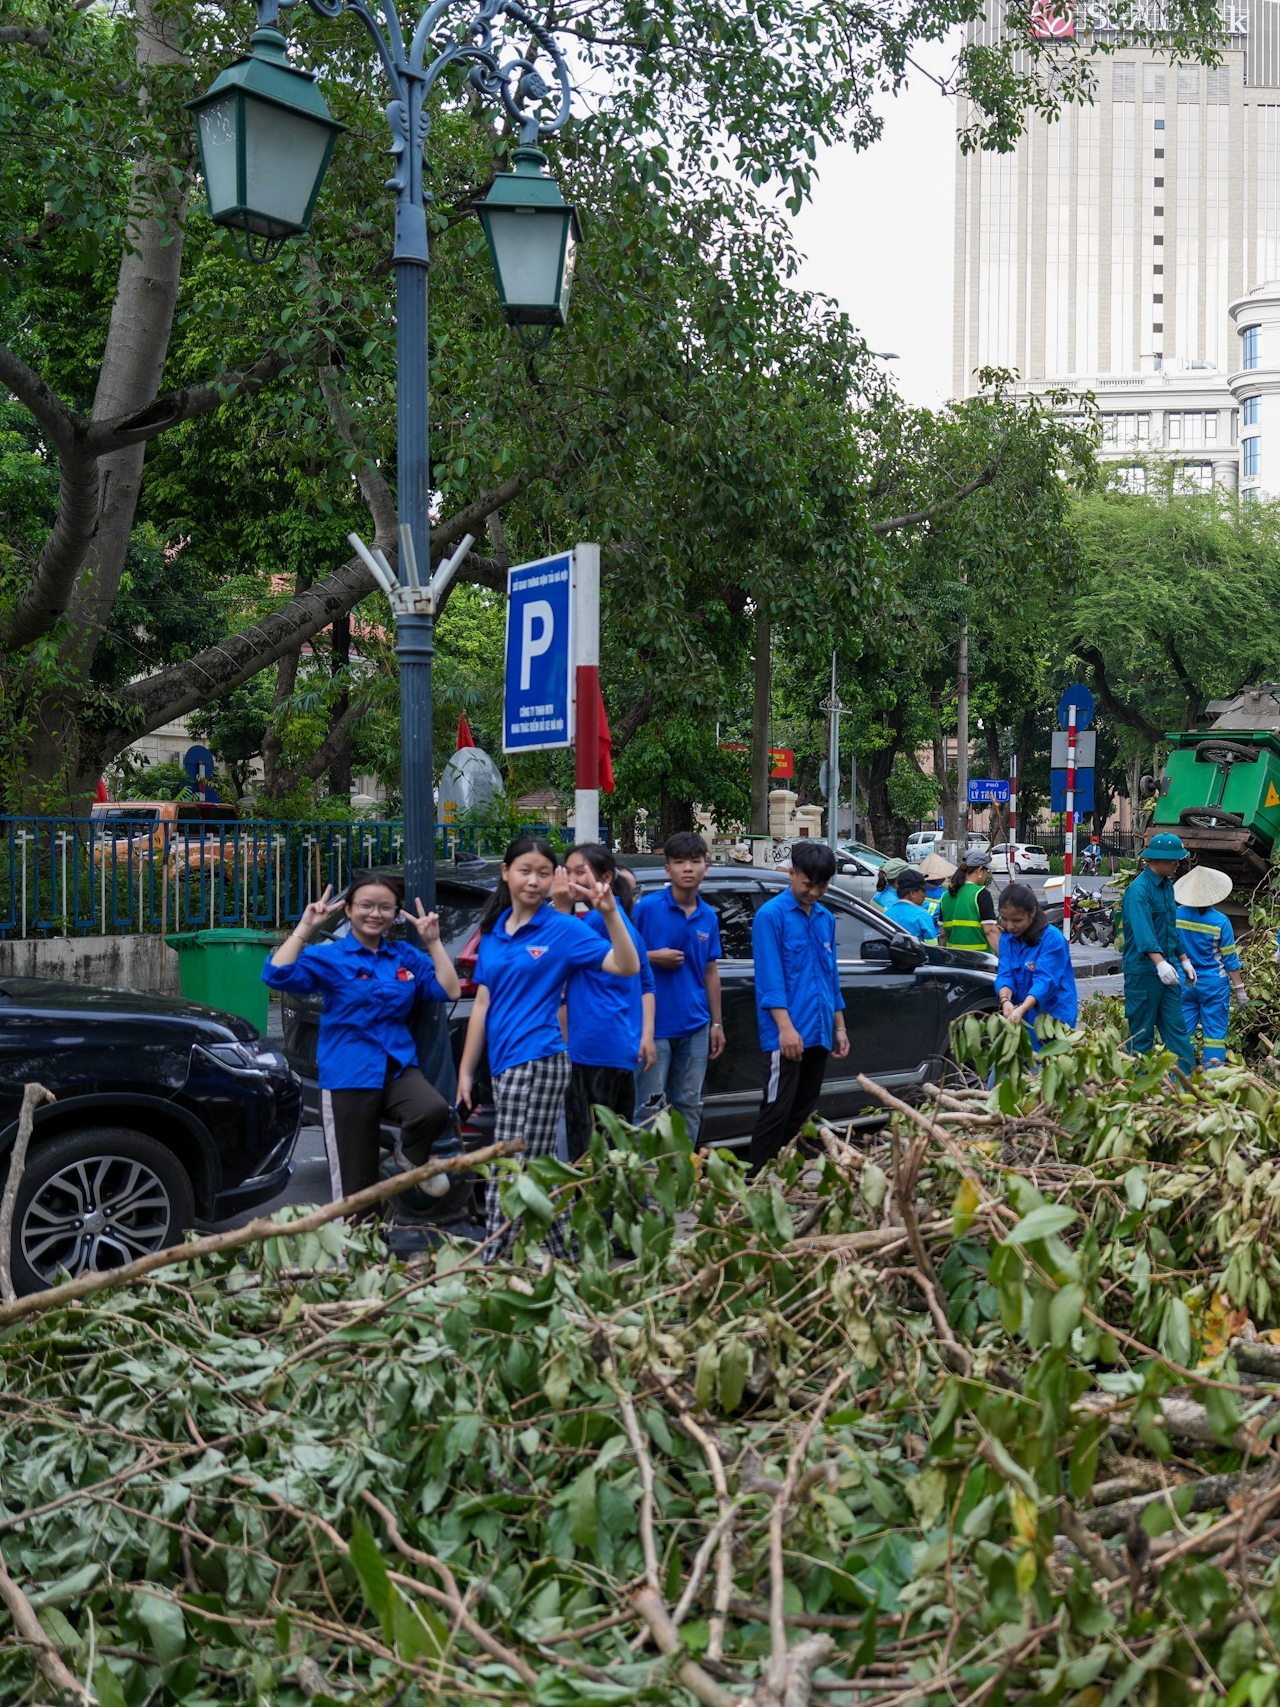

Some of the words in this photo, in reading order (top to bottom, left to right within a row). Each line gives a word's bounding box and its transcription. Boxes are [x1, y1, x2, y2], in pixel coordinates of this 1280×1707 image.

[520, 600, 554, 690] P
[971, 789, 979, 799] LÝ
[981, 789, 997, 799] THÁI
